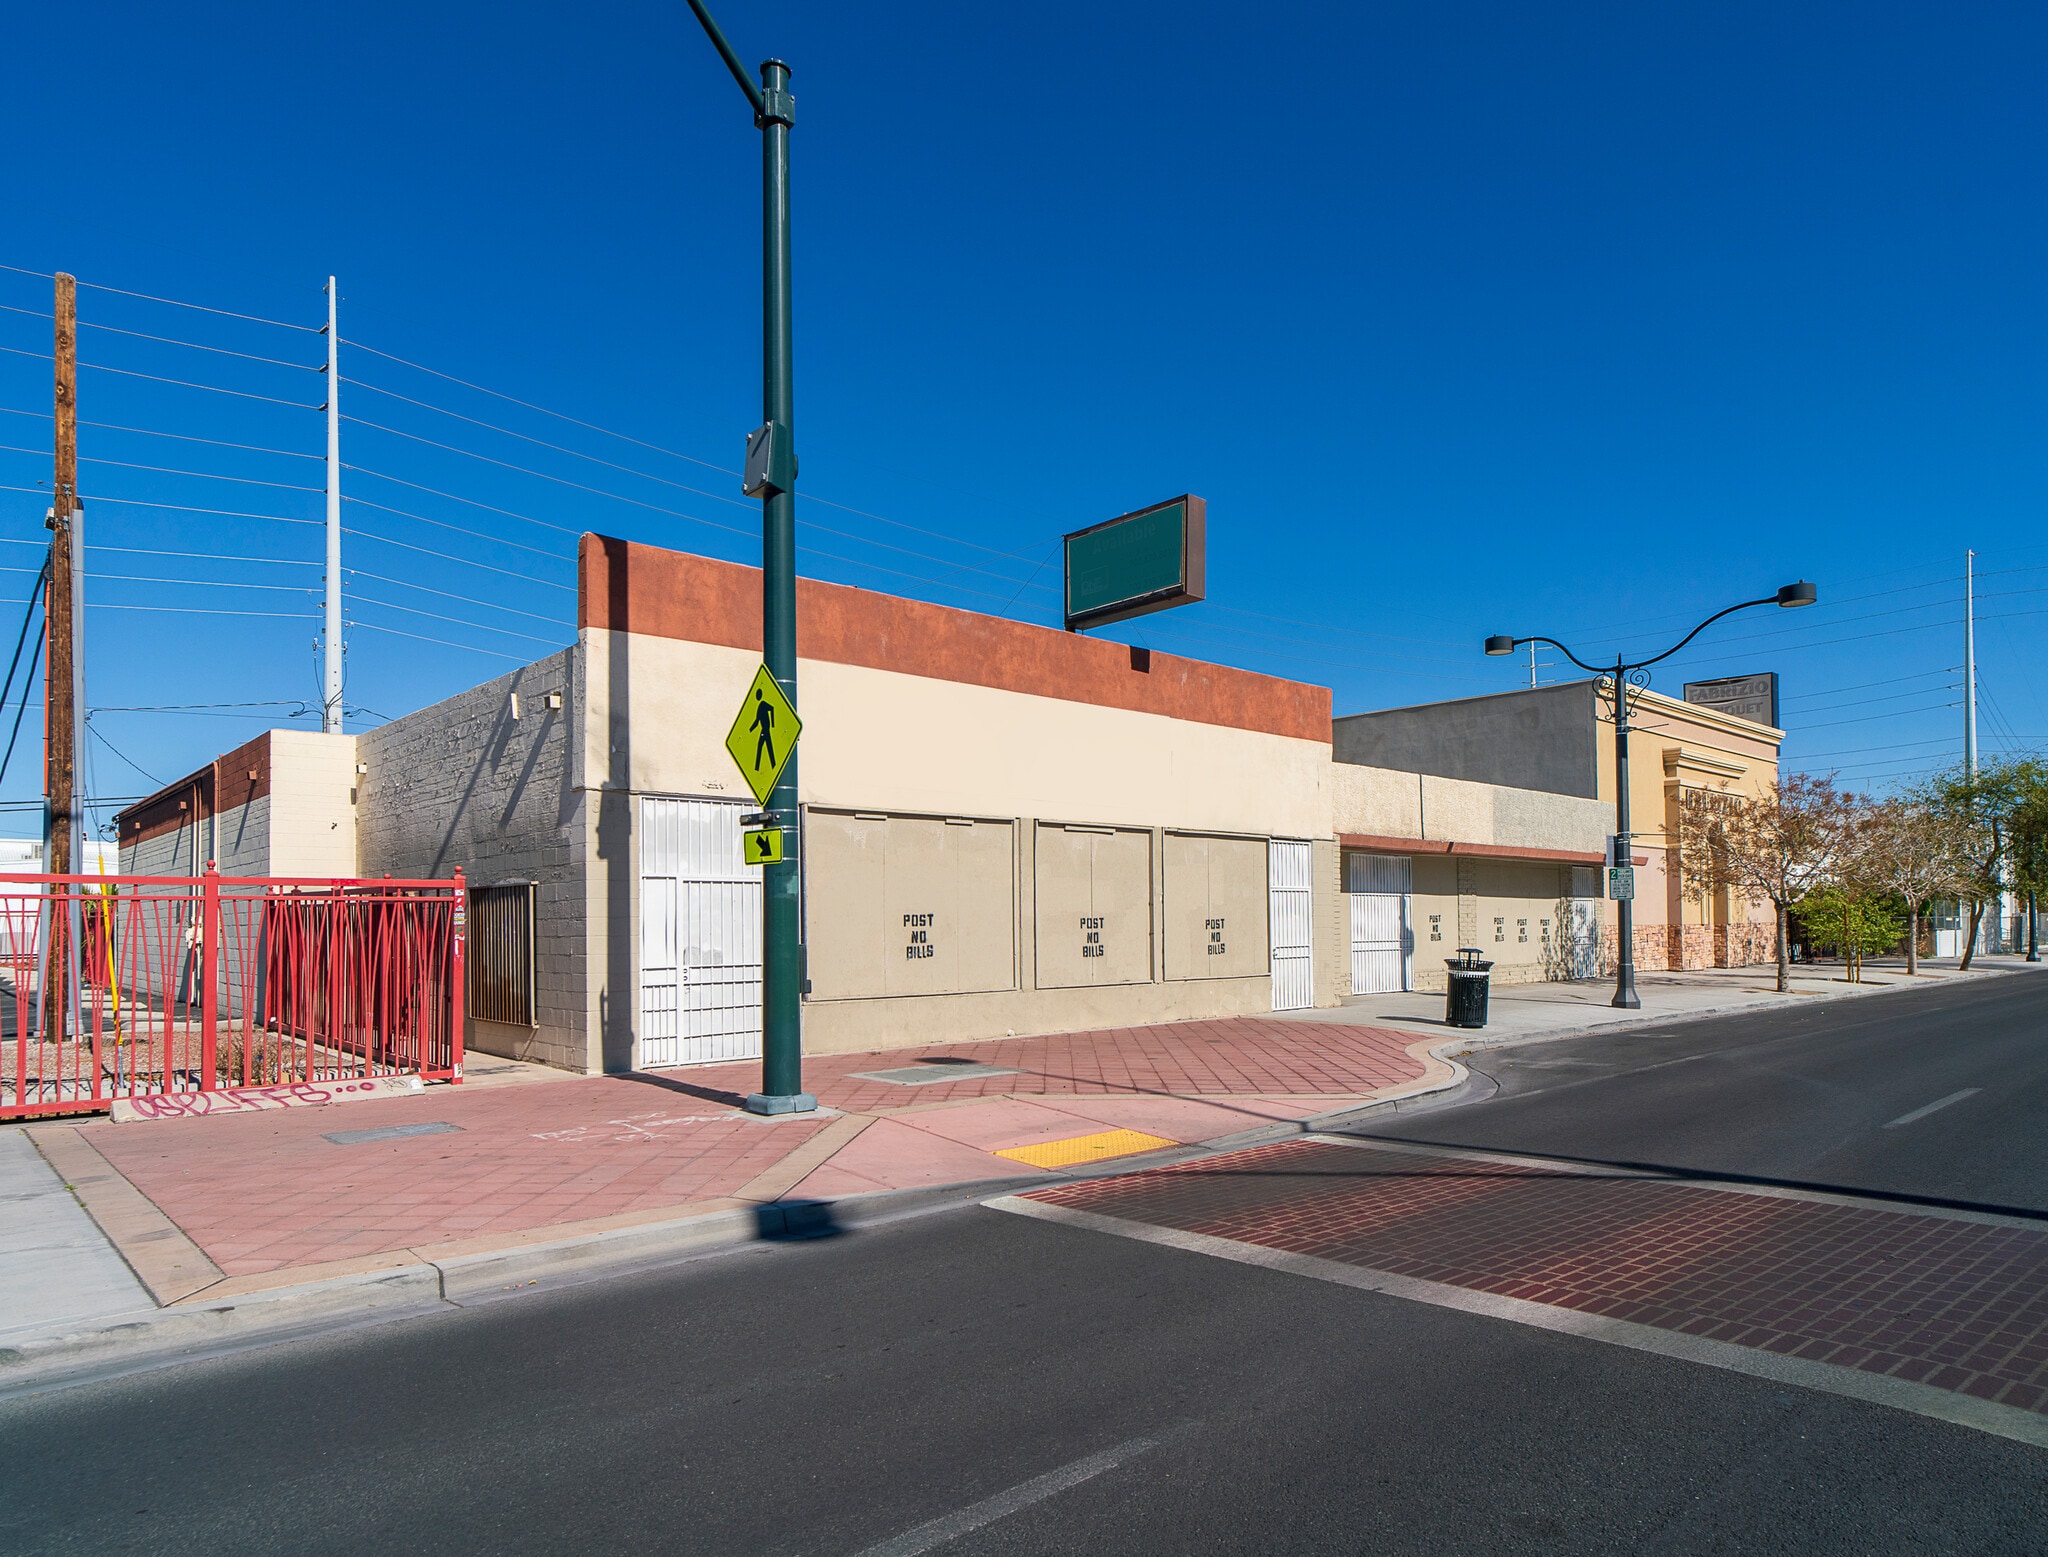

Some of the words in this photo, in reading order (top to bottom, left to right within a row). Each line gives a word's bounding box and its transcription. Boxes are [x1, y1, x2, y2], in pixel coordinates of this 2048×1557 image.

[1688, 680, 1768, 701] FABRIZIO
[1610, 870, 1617, 879] 2
[903, 913, 934, 927] POST
[1080, 917, 1105, 929] POST
[1205, 918, 1225, 930] POST
[1429, 914, 1441, 922] POST
[1516, 918, 1527, 926] POST
[911, 930, 927, 943] NO
[1087, 931, 1099, 943] NO
[1211, 931, 1221, 942] NO
[906, 944, 934, 960] BILLS
[1082, 944, 1104, 957] BILLS
[1208, 943, 1226, 955] BILLS
